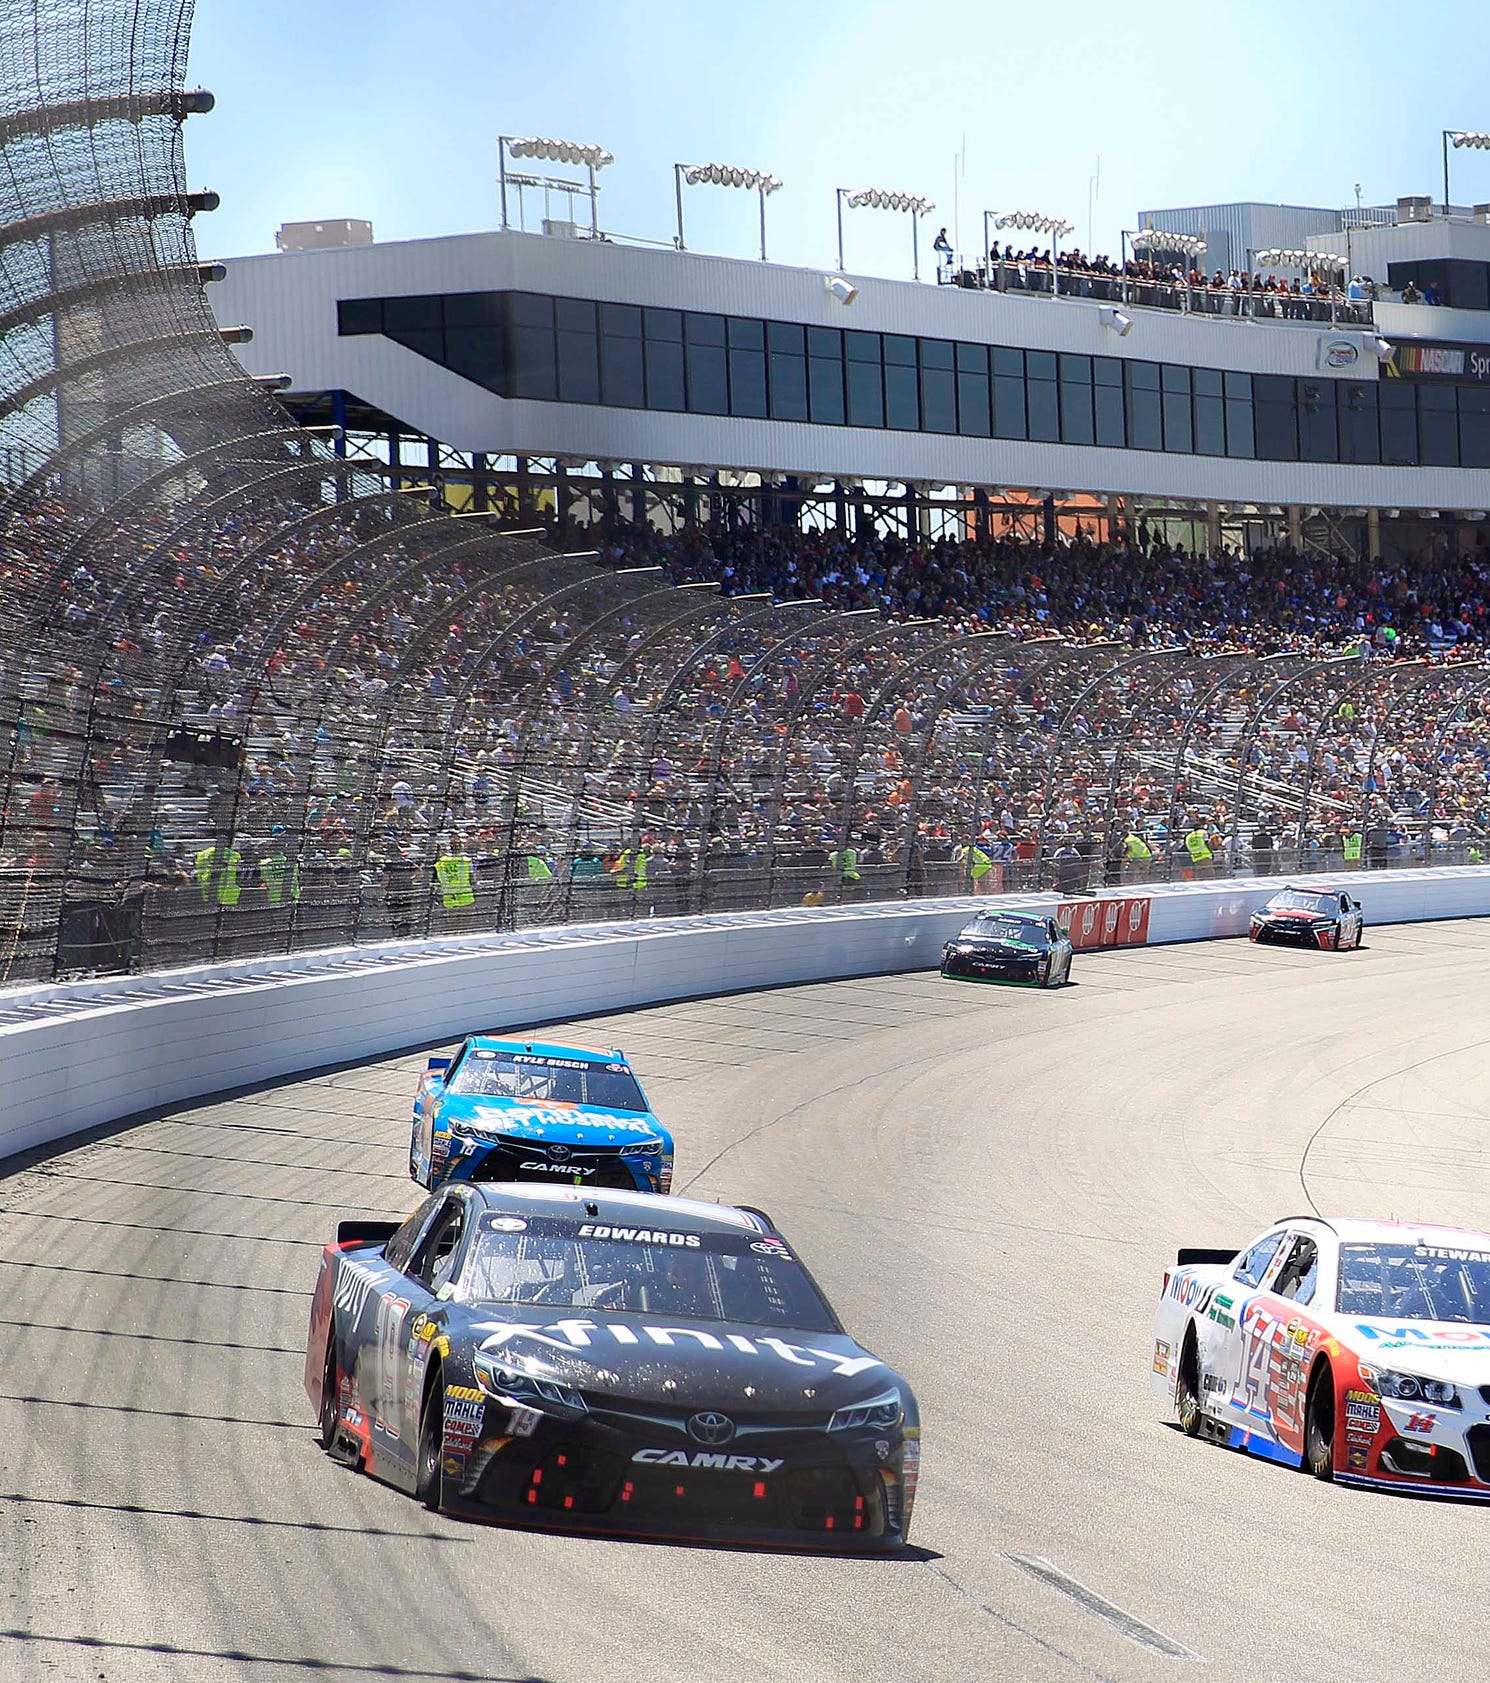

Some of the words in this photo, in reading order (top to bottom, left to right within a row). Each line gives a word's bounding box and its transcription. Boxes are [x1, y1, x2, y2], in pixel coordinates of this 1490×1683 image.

[512, 1055, 542, 1065] KYLE
[546, 1058, 588, 1070] BUSCH
[460, 1143, 477, 1156] 18
[520, 1162, 596, 1176] CAMRY
[578, 1224, 701, 1248] EDWARDS
[469, 1320, 884, 1377] xfinity
[1229, 1305, 1283, 1421] 14
[446, 1384, 486, 1403] MOOG
[1346, 1390, 1380, 1404] MOOG
[445, 1400, 485, 1420] MAHLE
[1346, 1403, 1379, 1419] MAHLE
[445, 1419, 473, 1433] COMP
[504, 1409, 542, 1437] 19
[1404, 1411, 1436, 1433] 14
[631, 1449, 784, 1473] CAMRY
